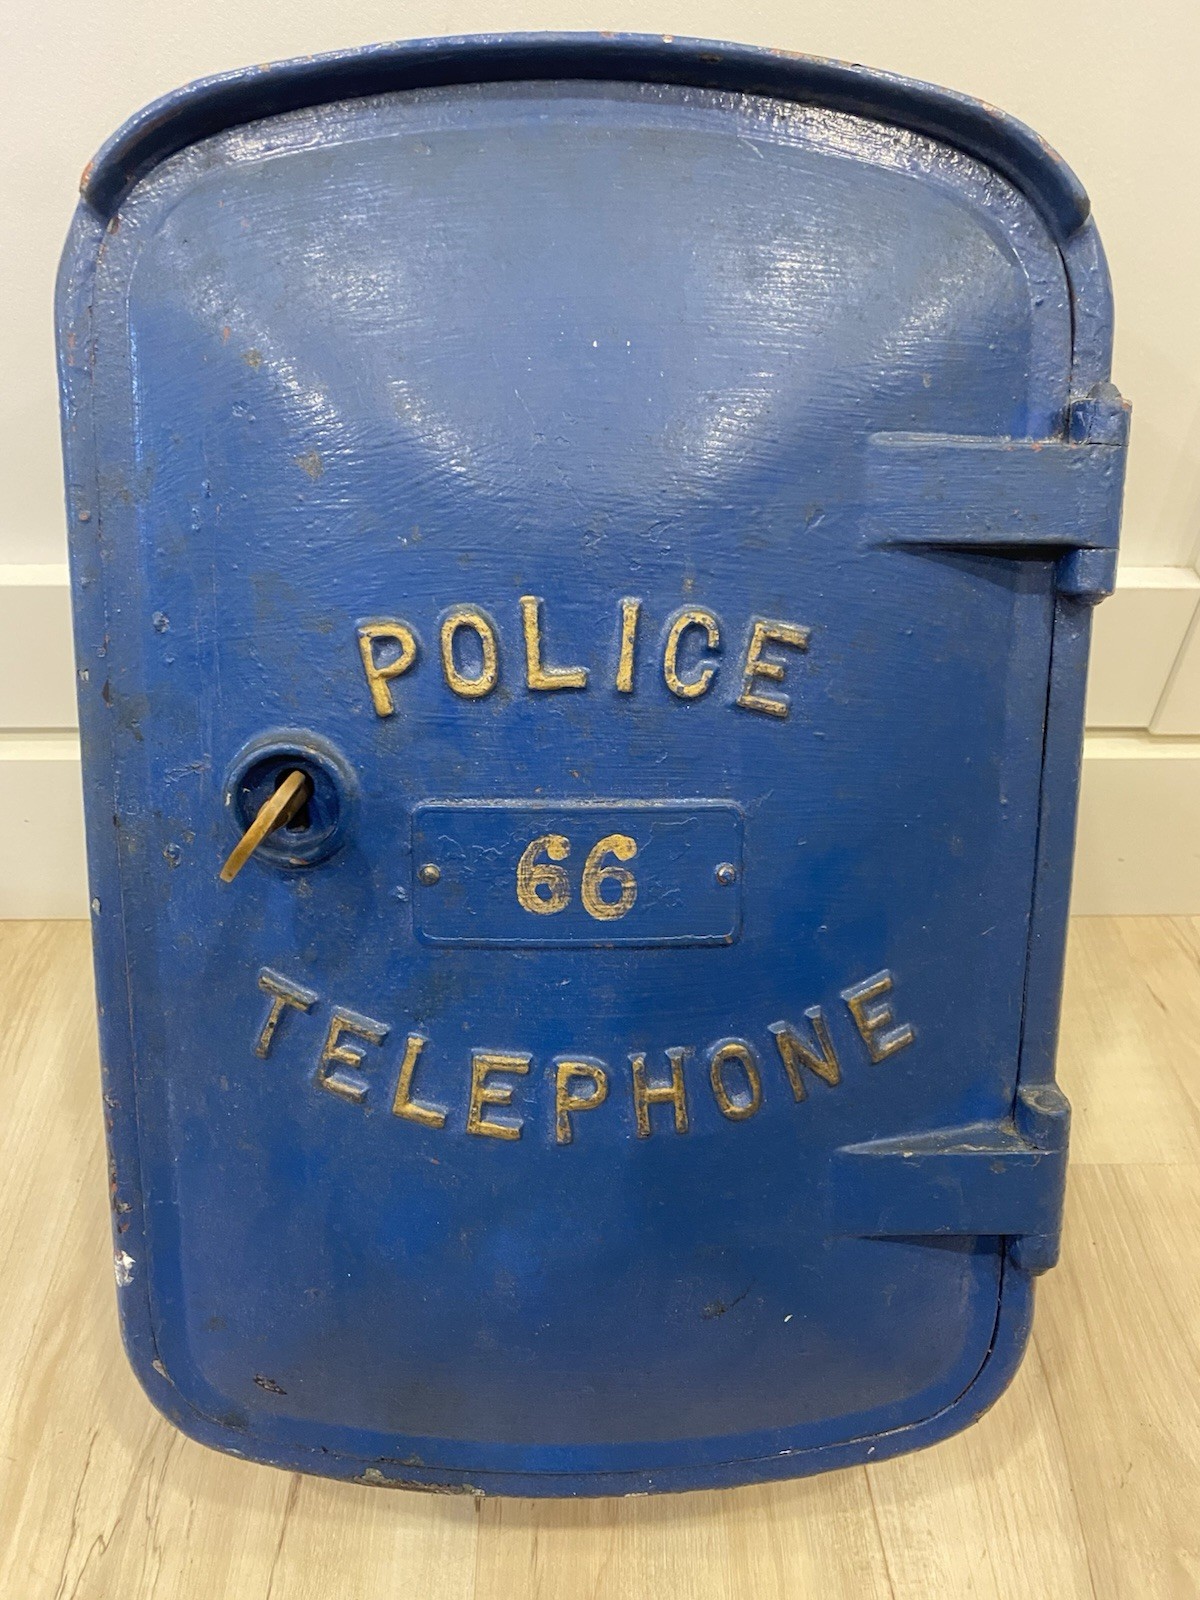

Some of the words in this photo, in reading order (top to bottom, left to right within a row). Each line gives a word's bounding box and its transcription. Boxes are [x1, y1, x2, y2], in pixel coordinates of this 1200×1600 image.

[355, 595, 810, 719] POLICE
[516, 833, 638, 922] 66
[253, 966, 916, 1144] TELEPHONE
